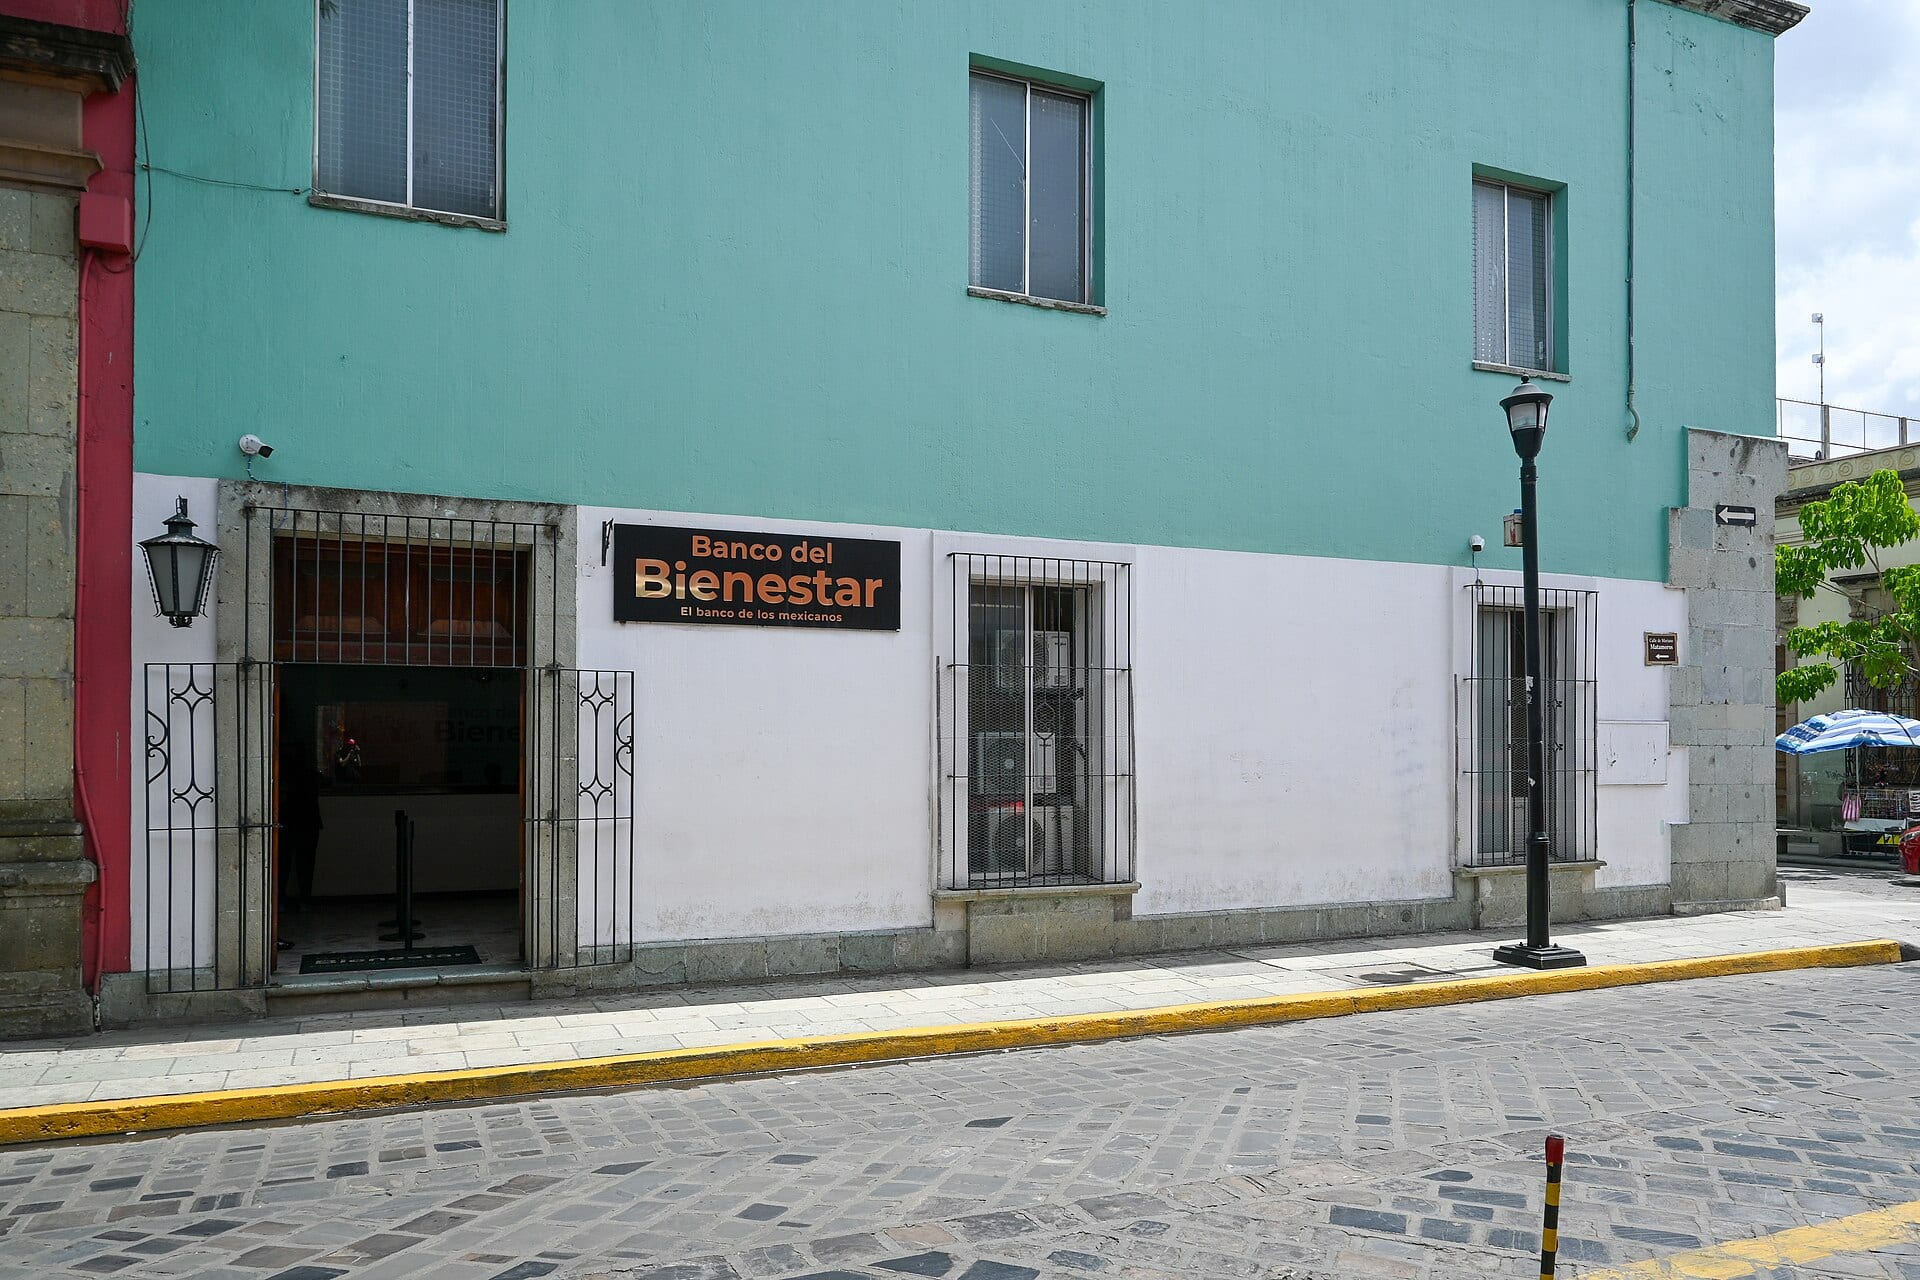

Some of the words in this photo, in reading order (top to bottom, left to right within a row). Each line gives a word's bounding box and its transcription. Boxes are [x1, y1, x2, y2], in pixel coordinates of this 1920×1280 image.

[692, 535, 782, 562] Banco
[791, 541, 833, 564] del
[635, 558, 883, 608] Bienestar
[680, 606, 692, 617] El
[696, 607, 735, 619] banco
[738, 608, 753, 619] de
[757, 609, 775, 620] los
[778, 611, 843, 622] mexicanos
